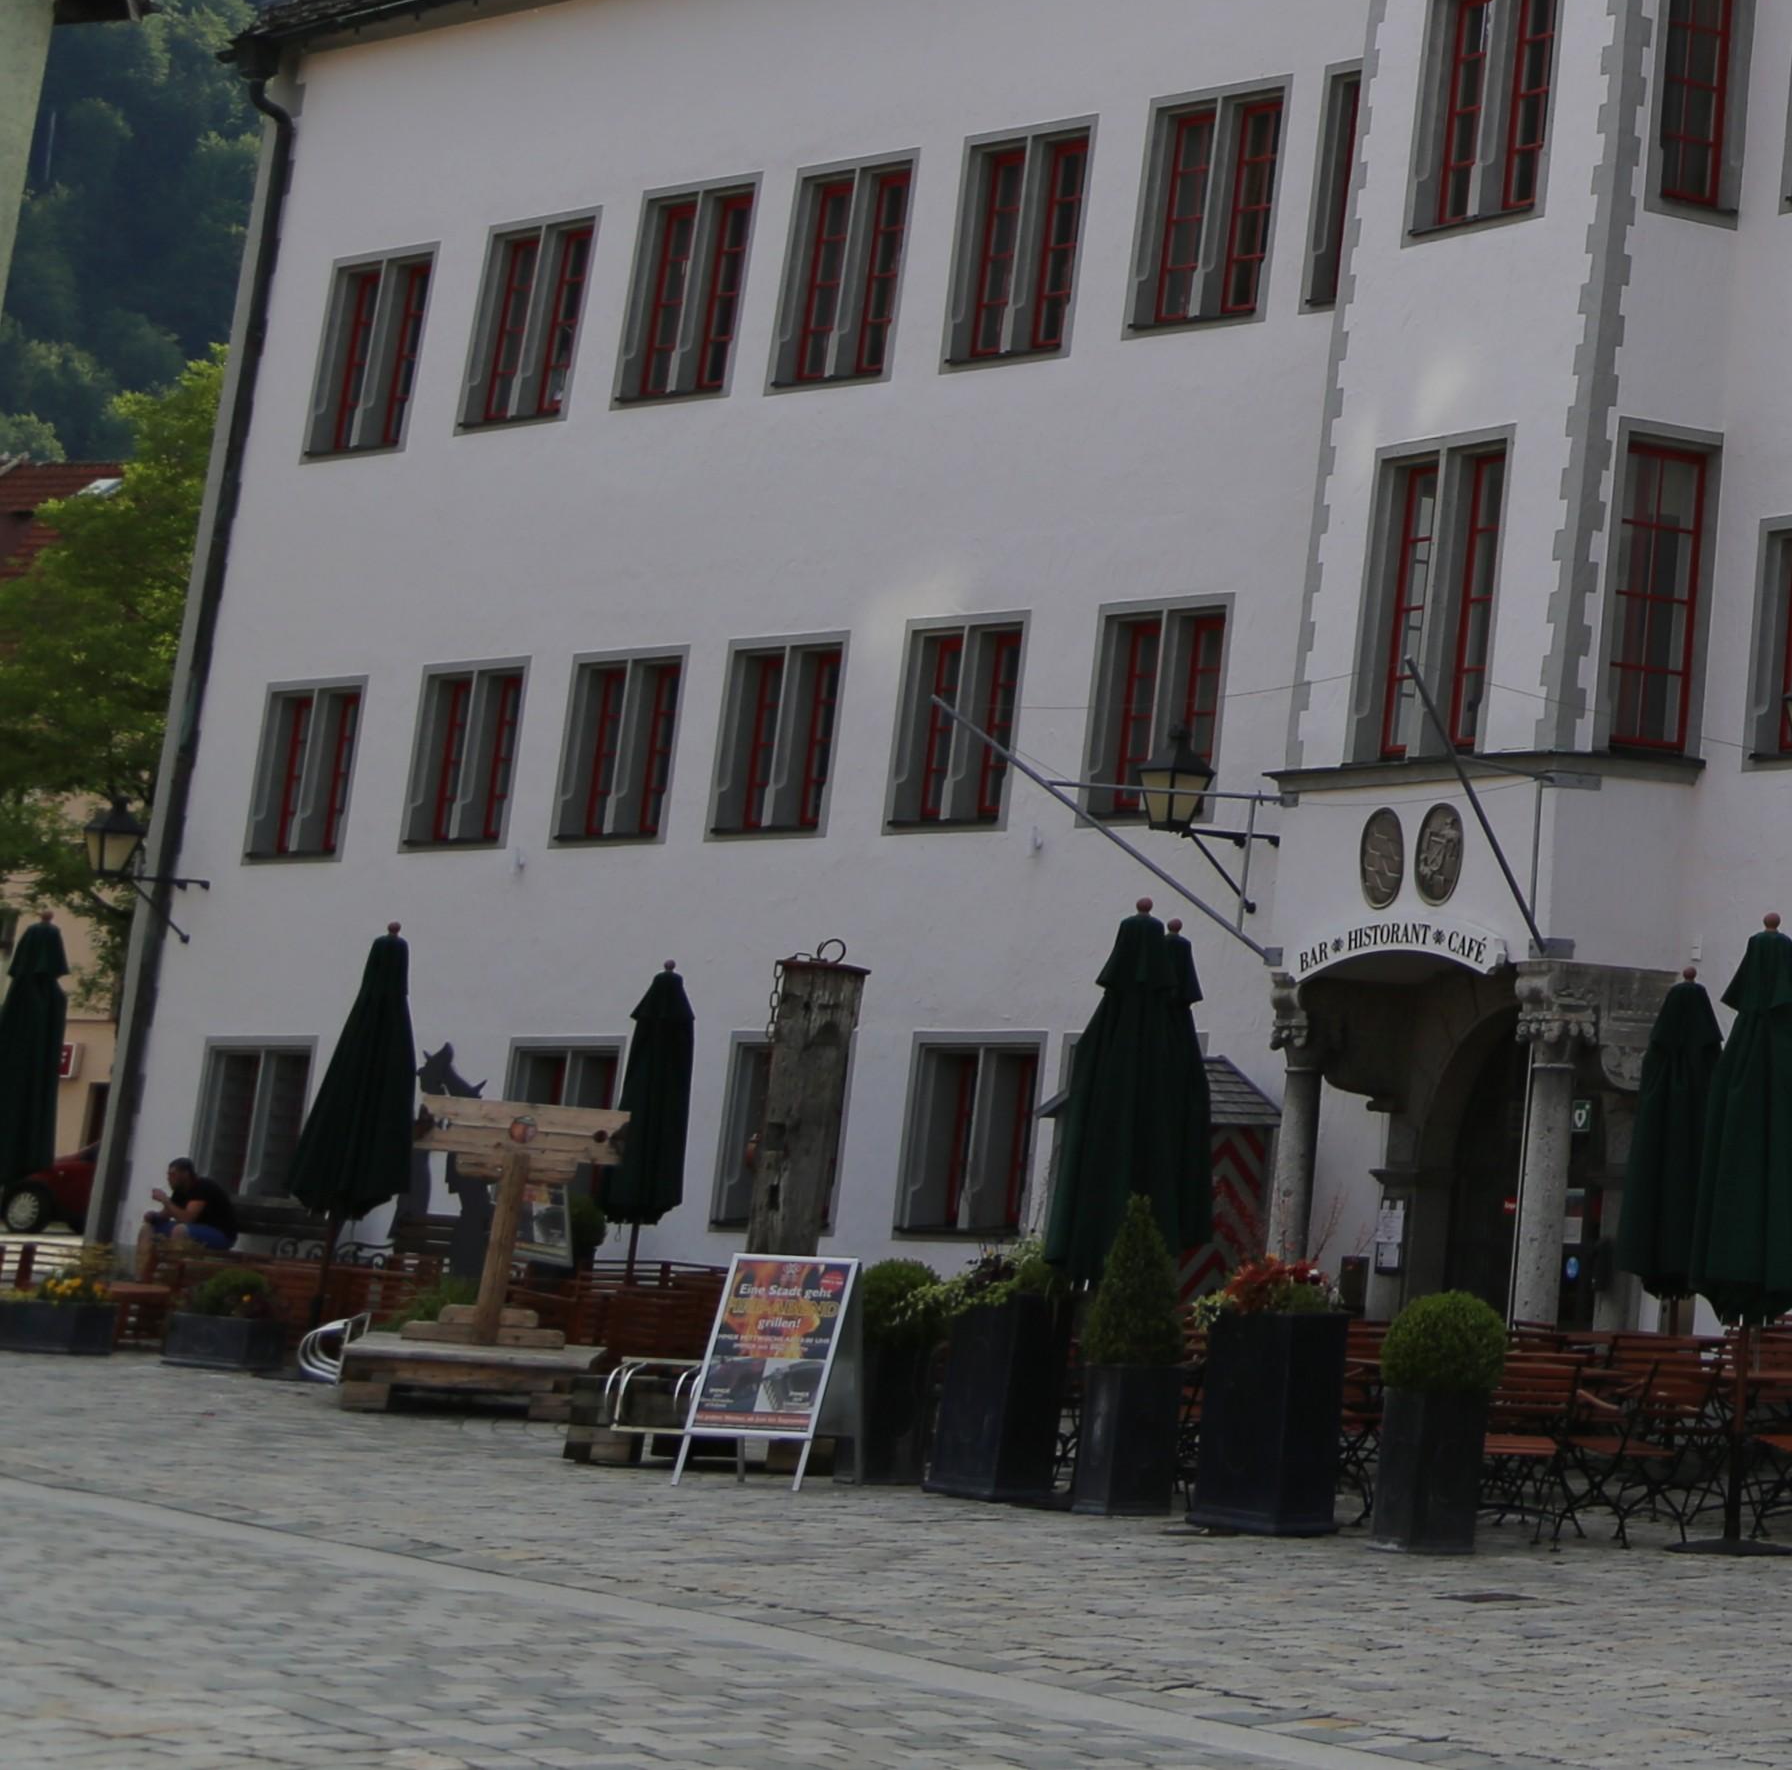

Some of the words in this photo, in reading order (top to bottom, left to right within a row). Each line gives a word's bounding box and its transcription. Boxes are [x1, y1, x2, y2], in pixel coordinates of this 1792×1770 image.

[1300, 941, 1329, 973] BAR
[1348, 923, 1431, 951] HISTORANT
[1448, 931, 1487, 965] CAFÉ
[739, 1283, 766, 1296] Eine
[768, 1284, 802, 1297] Stadt
[804, 1287, 832, 1300] geht
[757, 1317, 802, 1330] grillen!
